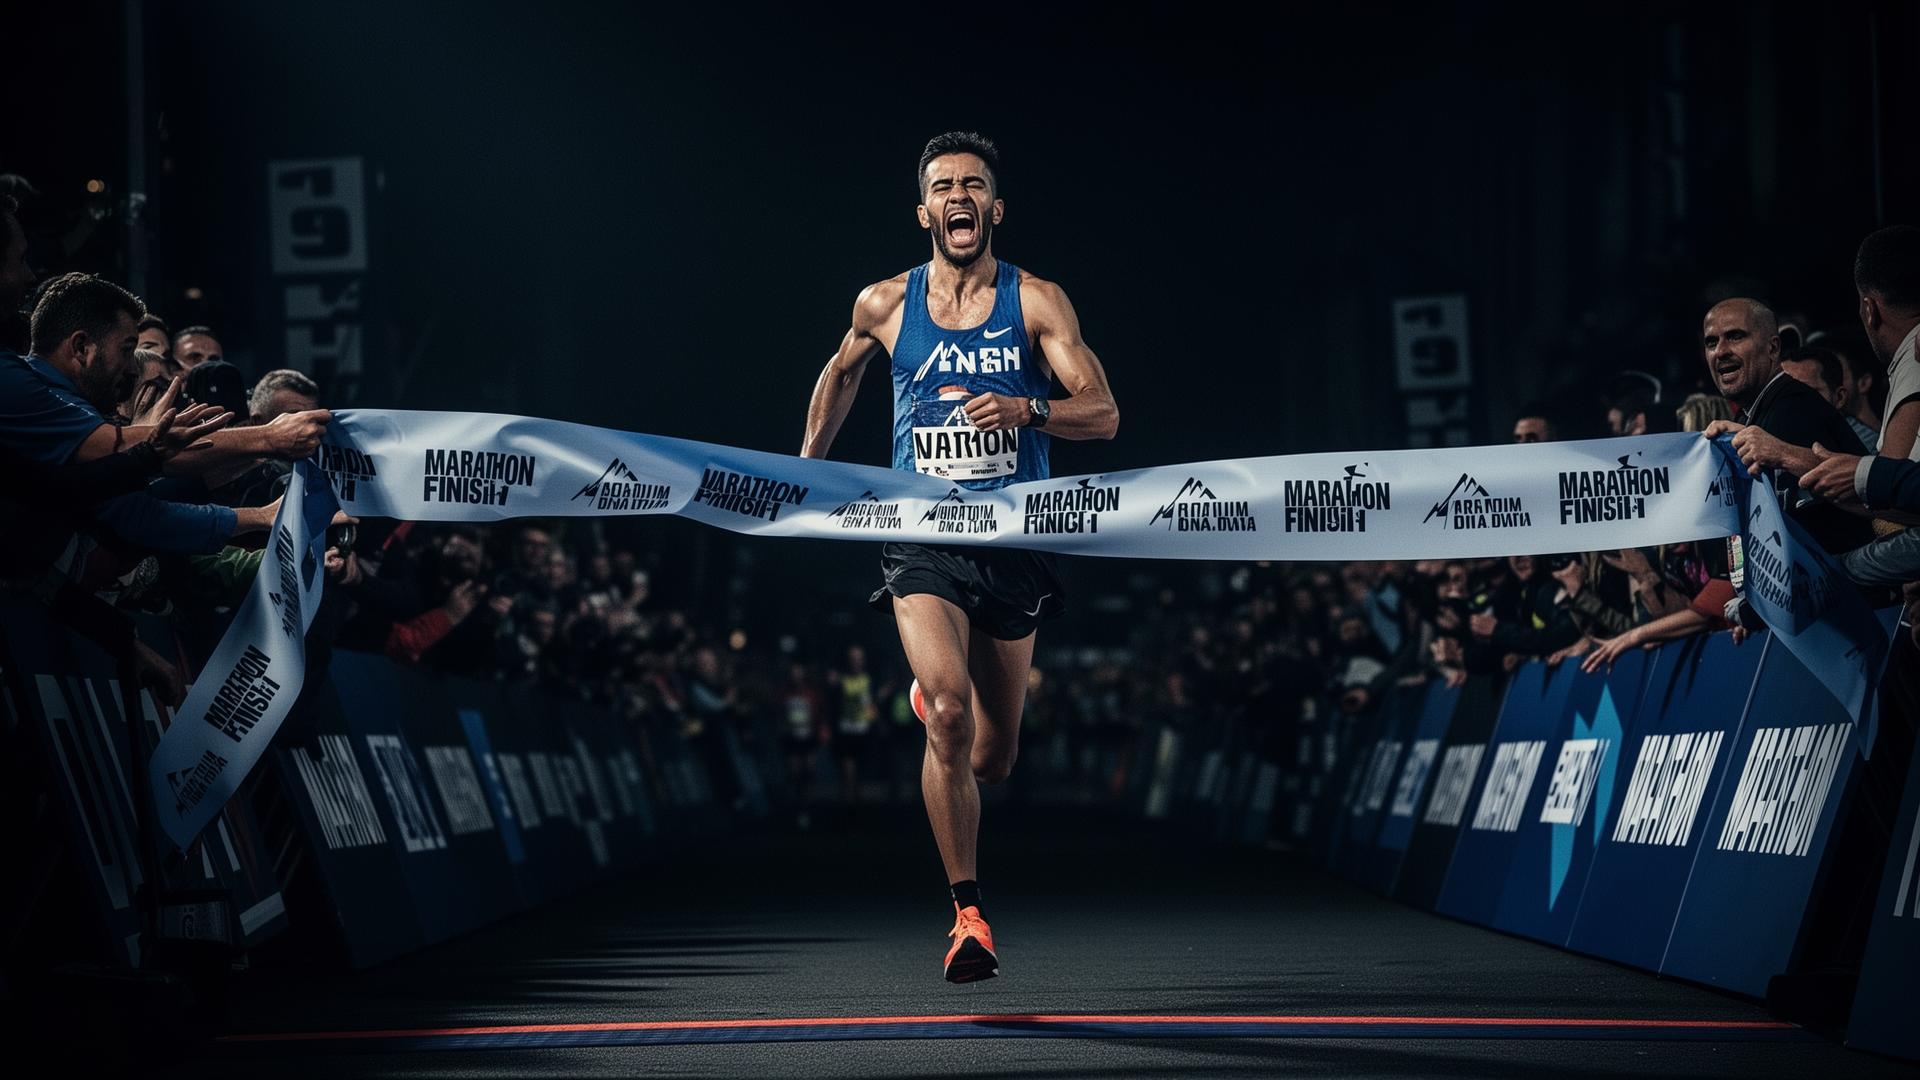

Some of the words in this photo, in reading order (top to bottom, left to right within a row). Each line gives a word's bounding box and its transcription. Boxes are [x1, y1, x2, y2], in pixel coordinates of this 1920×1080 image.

[424, 449, 536, 487] MARATHON
[1558, 466, 1670, 500] MARATHON
[1025, 486, 1121, 515] MARATHON
[1284, 475, 1391, 511] MARATHON
